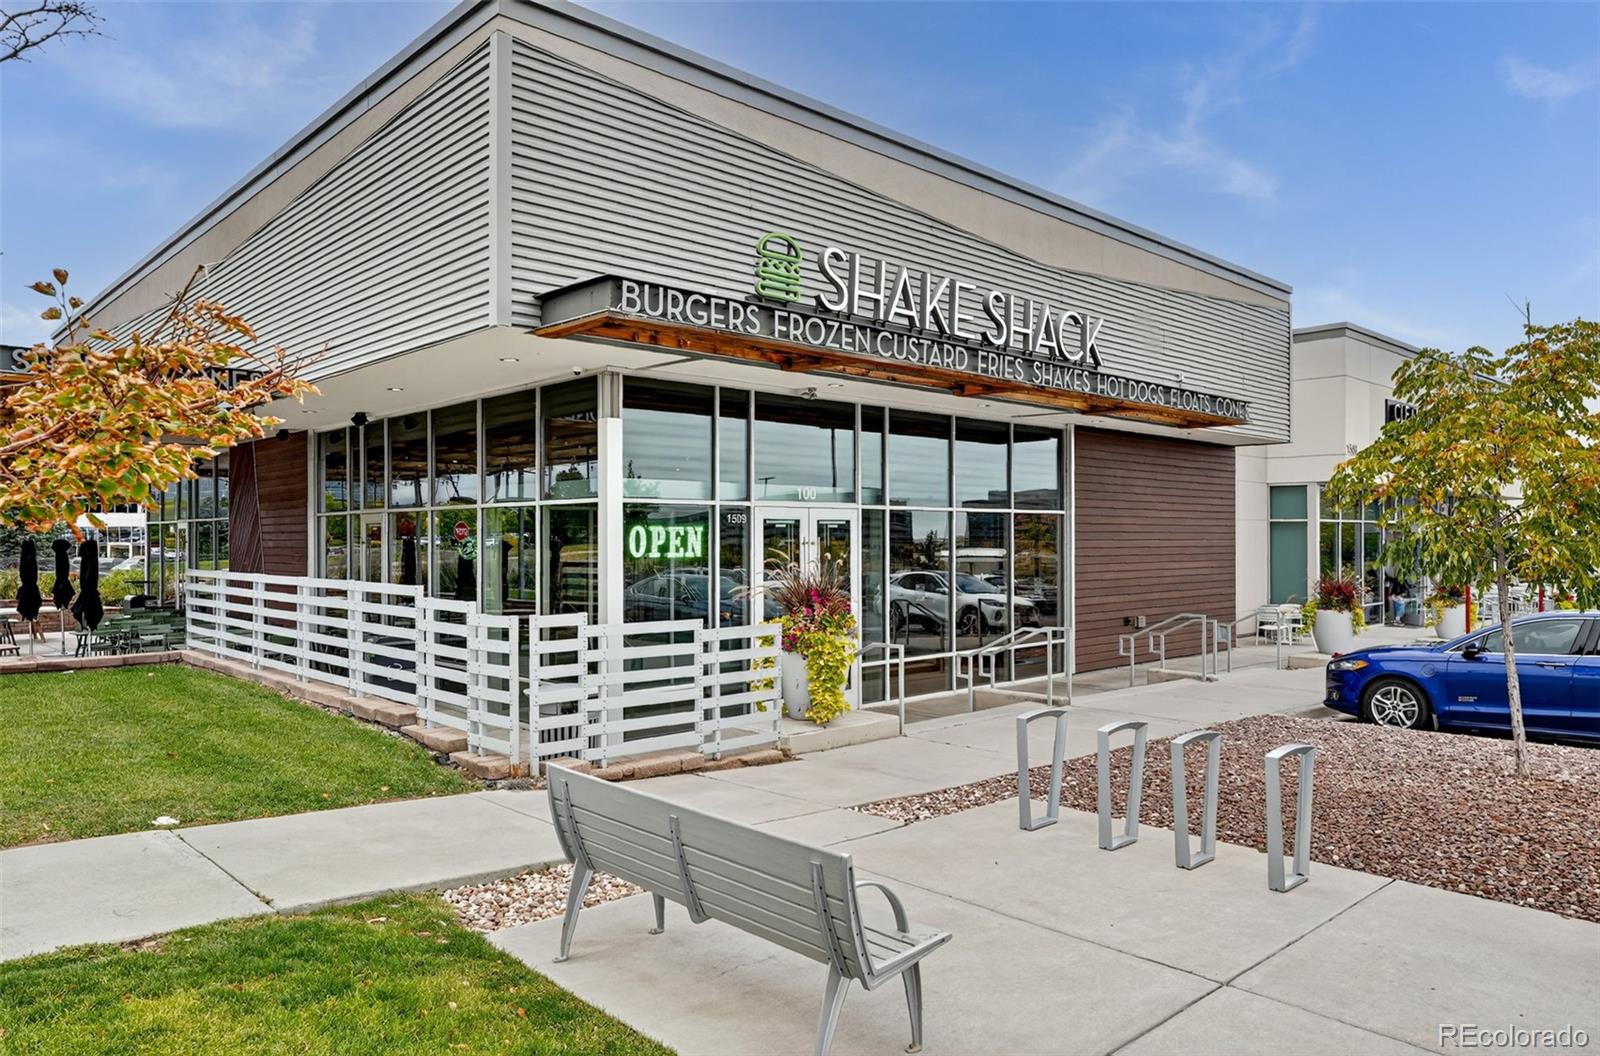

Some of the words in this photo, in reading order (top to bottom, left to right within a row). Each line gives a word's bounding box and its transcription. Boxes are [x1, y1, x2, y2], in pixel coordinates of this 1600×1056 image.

[815, 247, 976, 339] SHAKE
[982, 290, 1104, 366] SHACK
[621, 280, 761, 335] BURGERS
[773, 310, 870, 353] FROZEN
[877, 331, 969, 371] CUSTARD
[977, 351, 1025, 382] FRIES
[1032, 363, 1091, 393] SHAKES
[1098, 374, 1126, 396] HOT
[1129, 381, 1165, 406] DOGS
[1171, 388, 1211, 412] FLOATS
[797, 486, 816, 500] 100
[727, 513, 747, 524] 1509
[628, 525, 704, 559] OPEN
